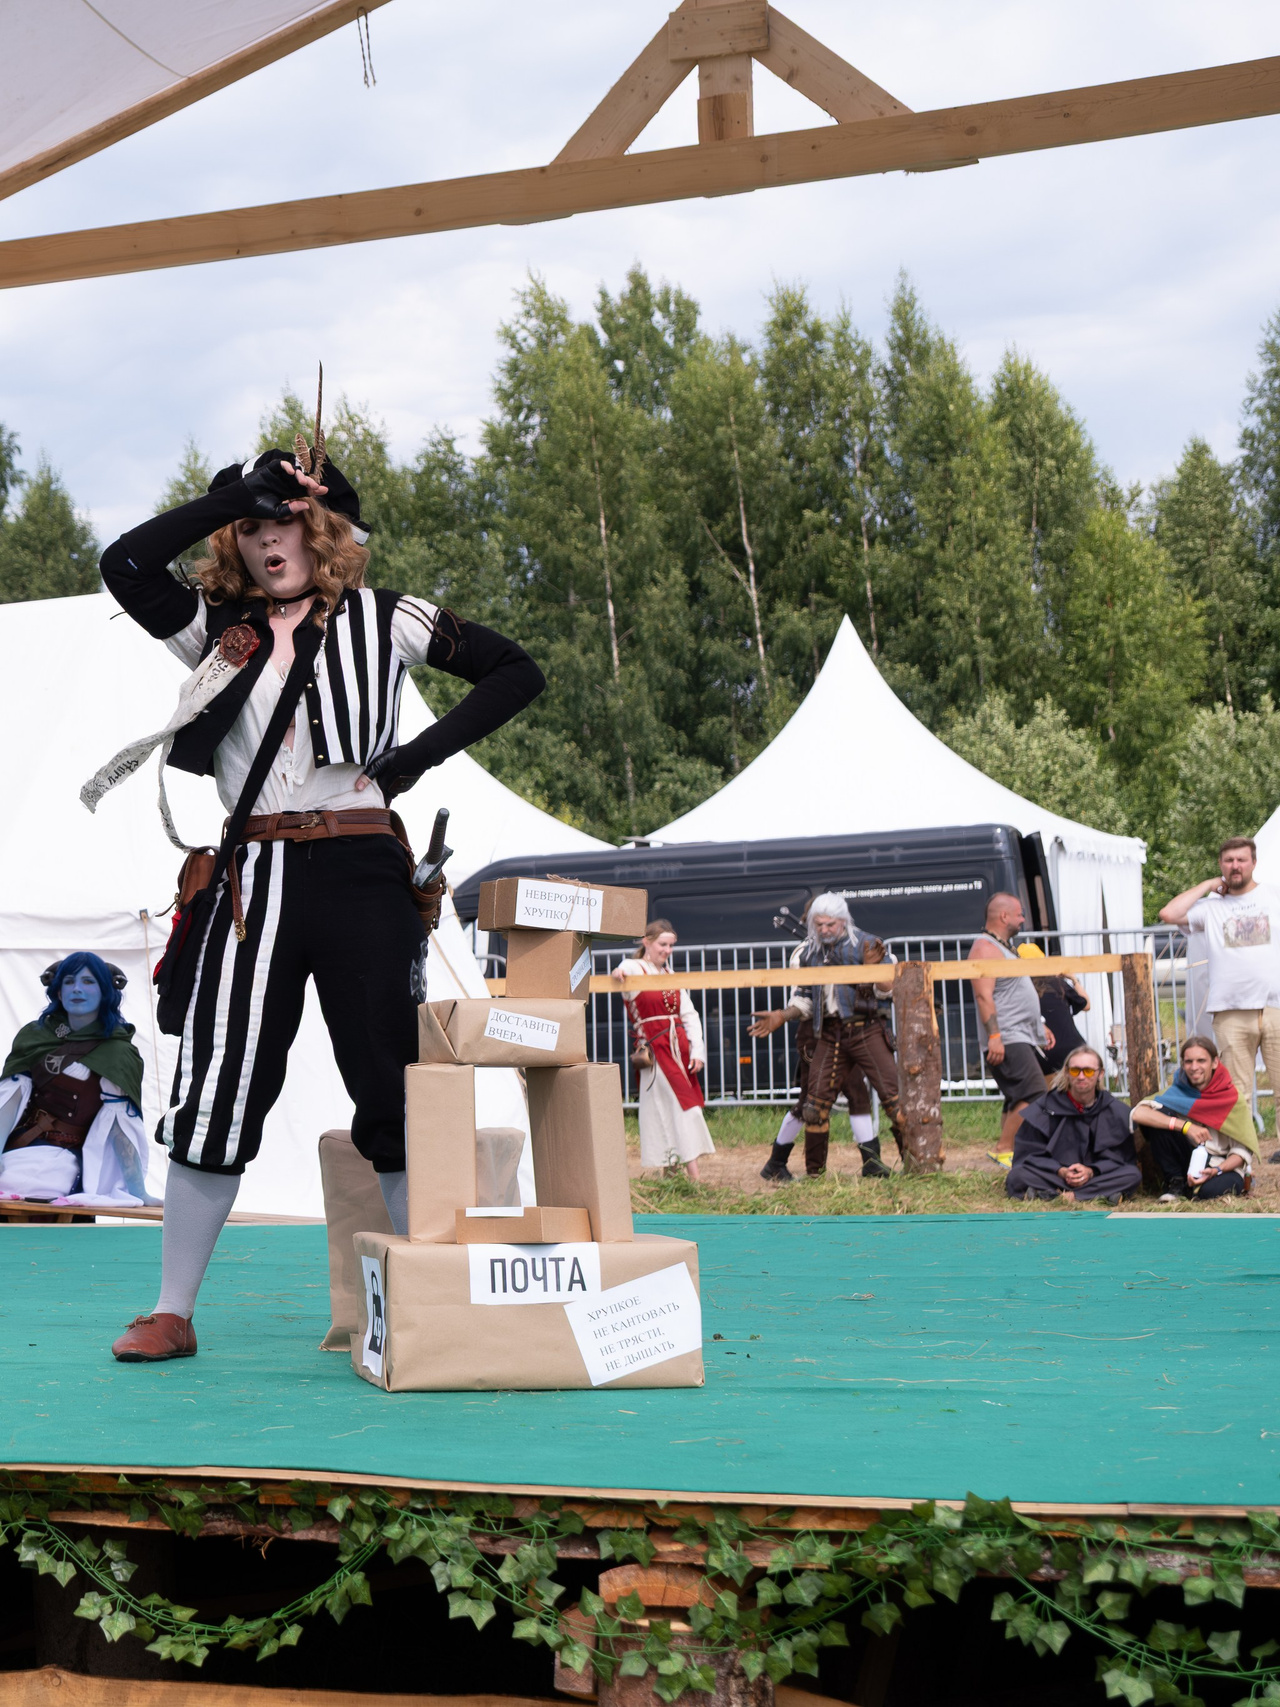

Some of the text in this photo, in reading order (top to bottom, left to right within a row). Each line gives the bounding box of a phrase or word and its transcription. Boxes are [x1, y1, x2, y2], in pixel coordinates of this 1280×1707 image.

[525, 888, 598, 908] НЕВЕРОЯТНО
[524, 906, 569, 921] ХРУПКО
[488, 1026, 523, 1043] ВЧЕРА
[491, 1011, 558, 1035] ДОСТАВИТЬ
[489, 1256, 588, 1294] ПОЧТА
[587, 1295, 642, 1323] ХРУПКОЕ
[592, 1302, 681, 1340] НЕ КАНТОВАТЬ
[599, 1327, 666, 1357] НЕ ТРЯСТИ,
[605, 1339, 676, 1372] НЕ ДЫШАТЬ
